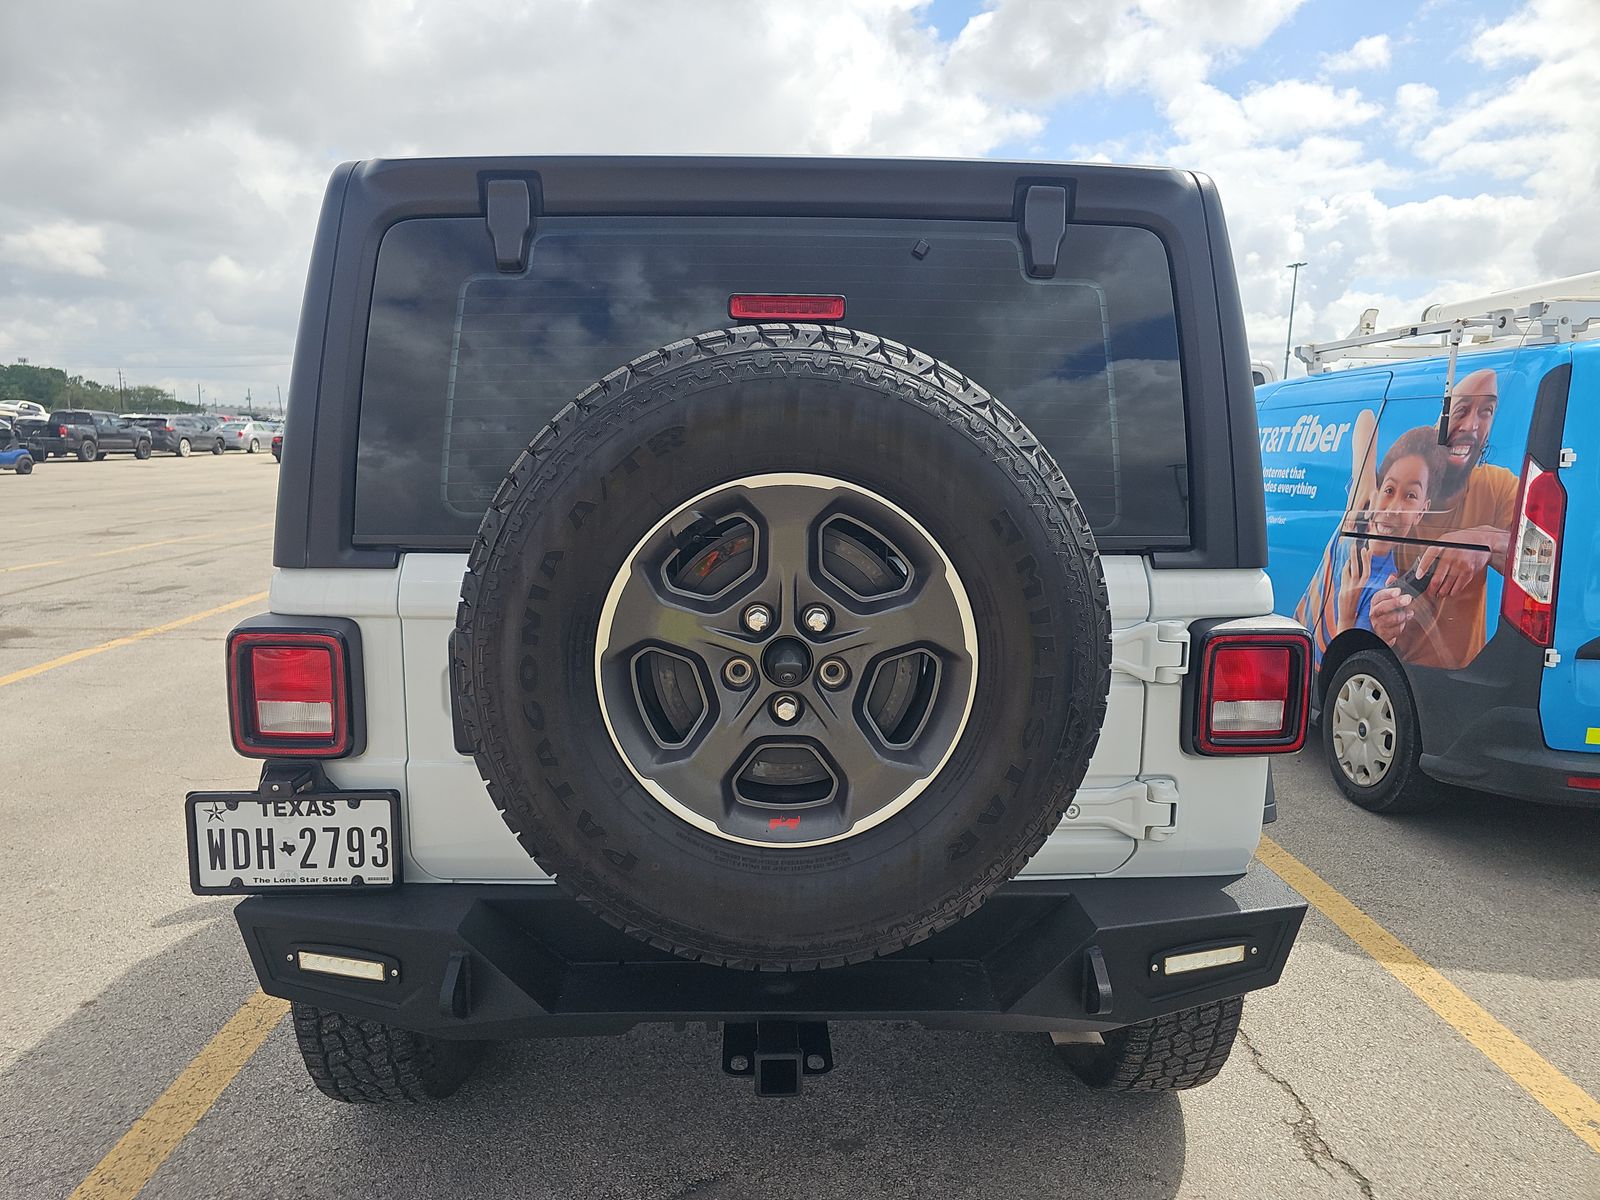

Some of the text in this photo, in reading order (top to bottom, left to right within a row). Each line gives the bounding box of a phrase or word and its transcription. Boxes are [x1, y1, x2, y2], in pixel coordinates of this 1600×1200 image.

[1259, 415, 1351, 453] T&T fiber
[1289, 466, 1306, 480] that
[1277, 482, 1318, 499] everything
[257, 800, 337, 818] TEXAS
[206, 826, 389, 871] WDH 2793
[273, 876, 298, 884] Lone
[322, 875, 348, 883] State
